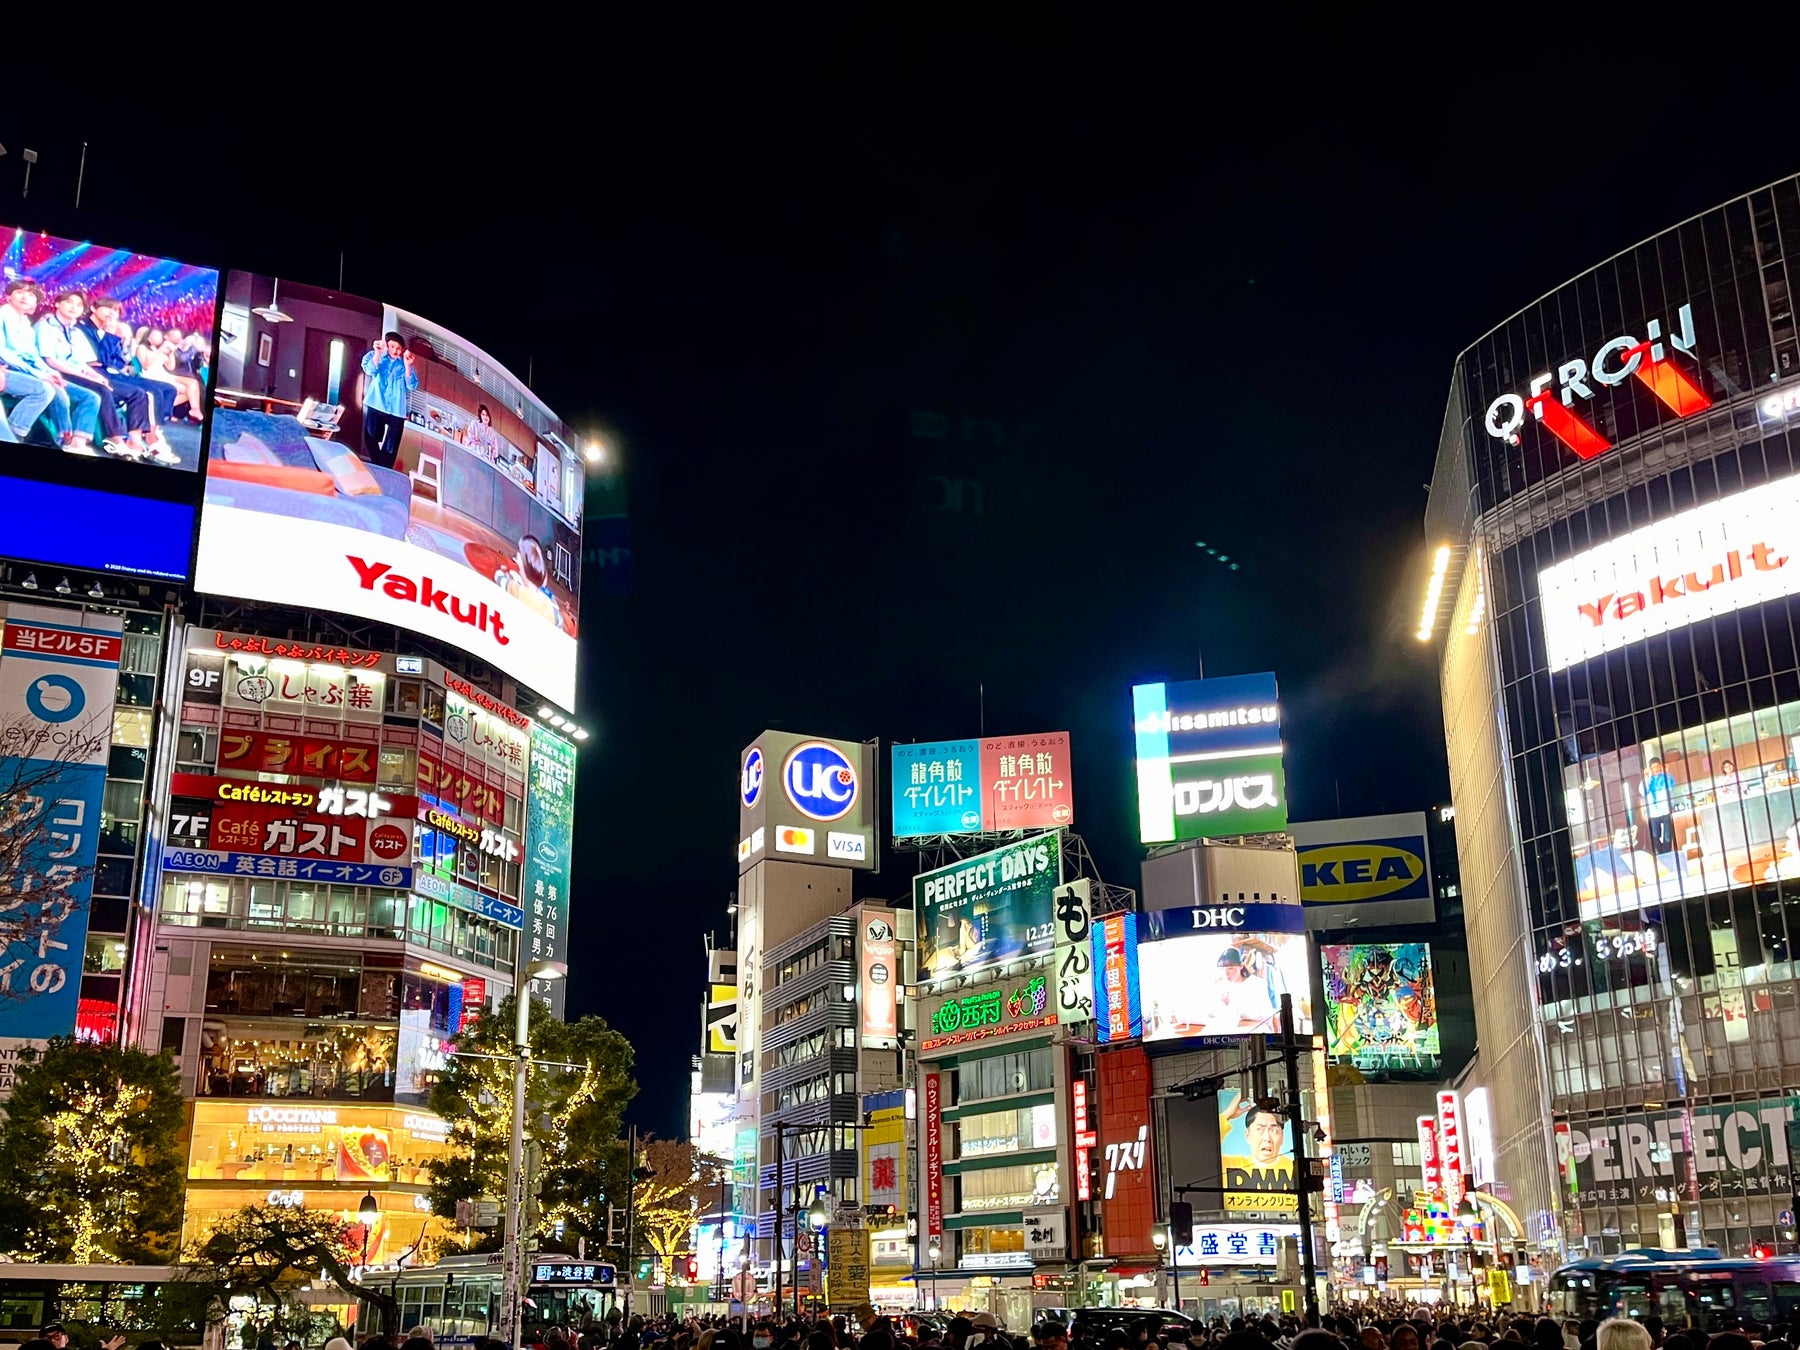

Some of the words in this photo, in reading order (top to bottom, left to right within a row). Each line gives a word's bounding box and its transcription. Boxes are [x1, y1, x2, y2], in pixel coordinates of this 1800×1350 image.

[1578, 542, 1789, 627] Yakult
[346, 555, 509, 646] Yakult
[16, 629, 110, 656] 当ビル5F
[215, 632, 381, 668] しゃぶしゃぶバイキング
[189, 669, 220, 688] 9F
[281, 675, 373, 709] しゃぶ葉
[223, 734, 371, 773] プライス
[472, 721, 522, 766] しゃぶ葉
[532, 750, 572, 785] PERFECT
[911, 759, 963, 784] 龍角散
[1000, 752, 1053, 777] 龍角散
[417, 756, 503, 819] コンタクト
[540, 773, 563, 797] DAYS
[904, 784, 973, 808] ダイレクト
[993, 777, 1064, 801] ダイレクト
[1172, 775, 1277, 815] ロンパス
[218, 784, 313, 806] Caféレストラン
[316, 788, 392, 818] ガスト
[172, 815, 209, 835] 7F
[218, 819, 259, 835] Café
[264, 820, 356, 856] ガスト
[375, 839, 404, 850] ガスト
[479, 828, 519, 861] ガスト
[833, 837, 862, 853] VISA
[172, 852, 220, 868] AEON
[235, 857, 297, 877] 英会話
[301, 863, 372, 881] イーオン
[925, 862, 996, 906] PERFECT
[1001, 845, 1050, 883] DAYS
[1302, 857, 1413, 887] KEA
[485, 903, 522, 923] イーオン
[1192, 908, 1245, 928] DHC
[1026, 922, 1055, 941] 12.22
[1057, 886, 1093, 1016] もんじゃ
[1105, 922, 1124, 1033] 三千里薬品
[962, 1001, 1000, 1028] 西村
[247, 1107, 337, 1124] L'OCCITANE
[927, 1090, 940, 1191] ウィンターフルーツギフト
[1572, 1107, 1794, 1182] PERFECT
[872, 1157, 895, 1190] 薬
[267, 1191, 303, 1207] Café
[1228, 1196, 1300, 1206] オンラインクリニ
[562, 1265, 595, 1277] 渋谷駅
